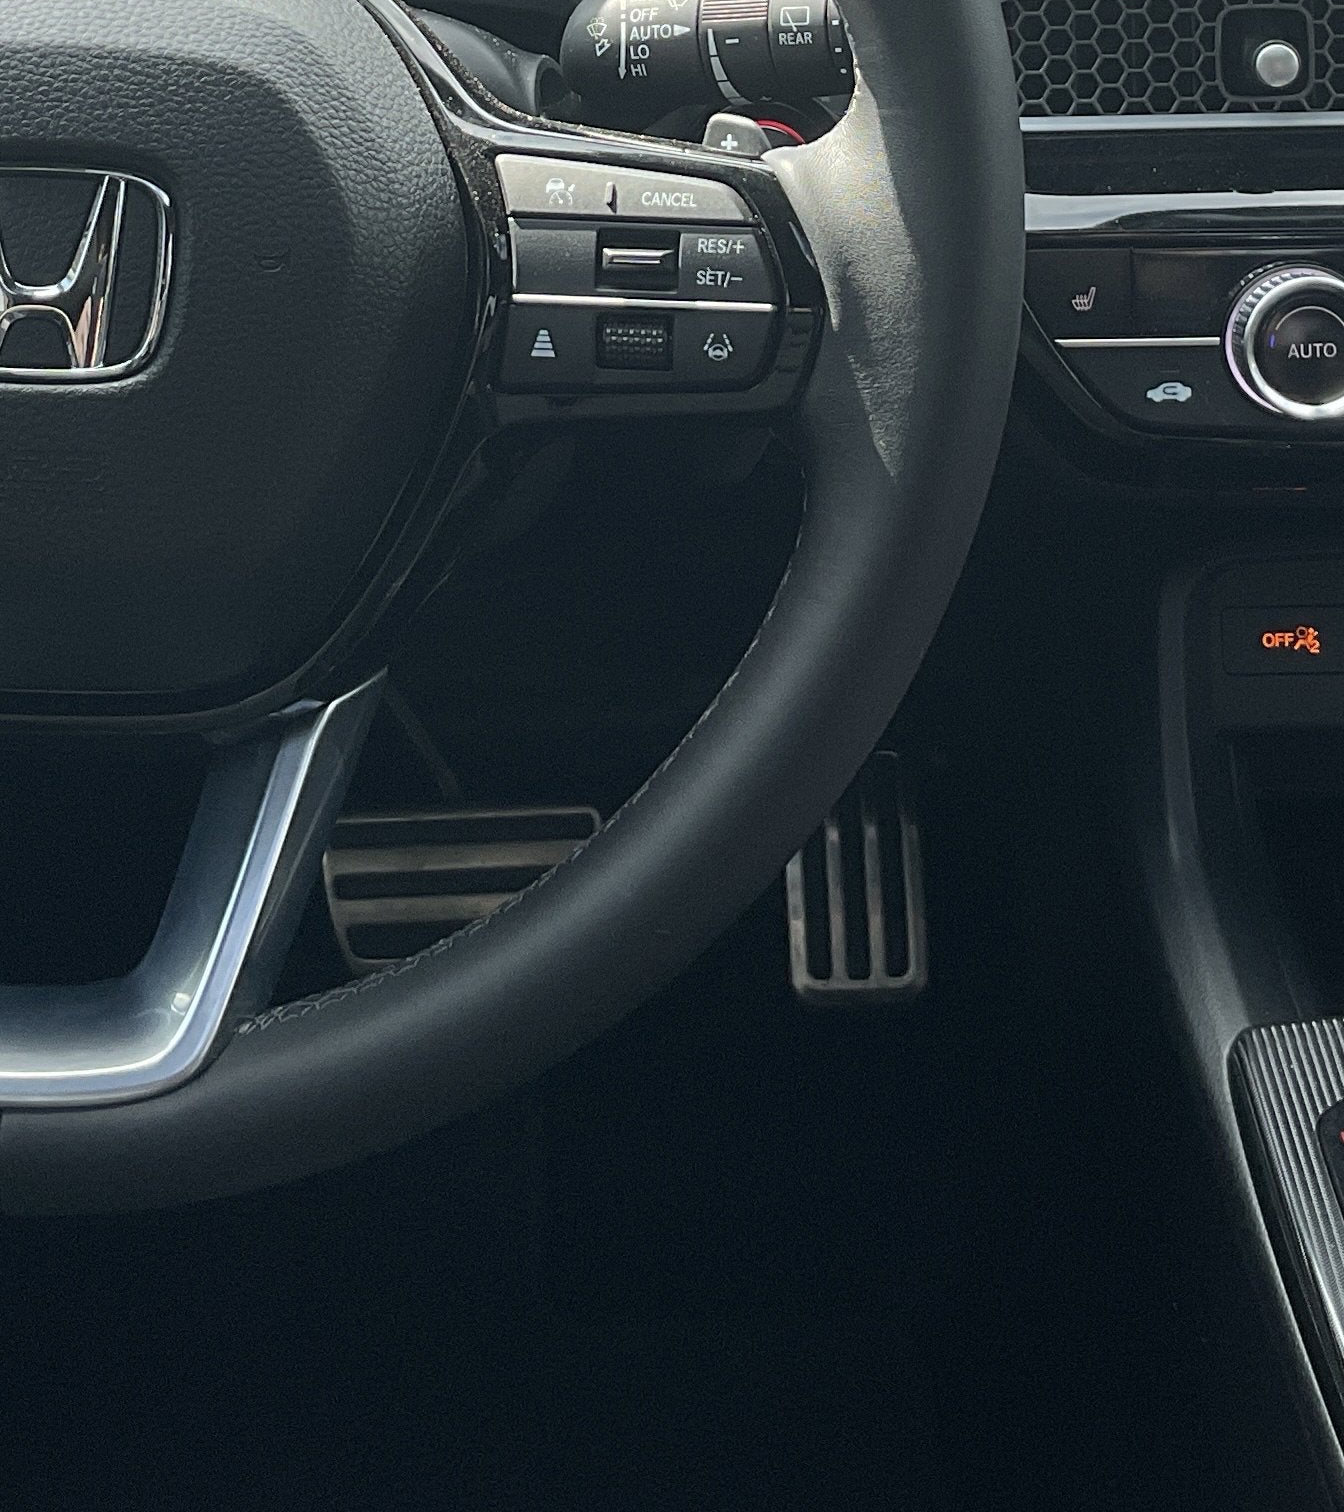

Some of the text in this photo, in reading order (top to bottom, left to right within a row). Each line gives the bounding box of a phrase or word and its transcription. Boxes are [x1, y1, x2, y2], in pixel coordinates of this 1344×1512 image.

[630, 7, 660, 23] OFF
[630, 24, 672, 39] AUTO
[778, 32, 813, 45] REAR
[630, 44, 650, 60] LO
[630, 63, 647, 77] HI
[641, 191, 697, 207] CANCEL
[1287, 343, 1337, 359] AUTO
[1262, 632, 1295, 648] OFF
